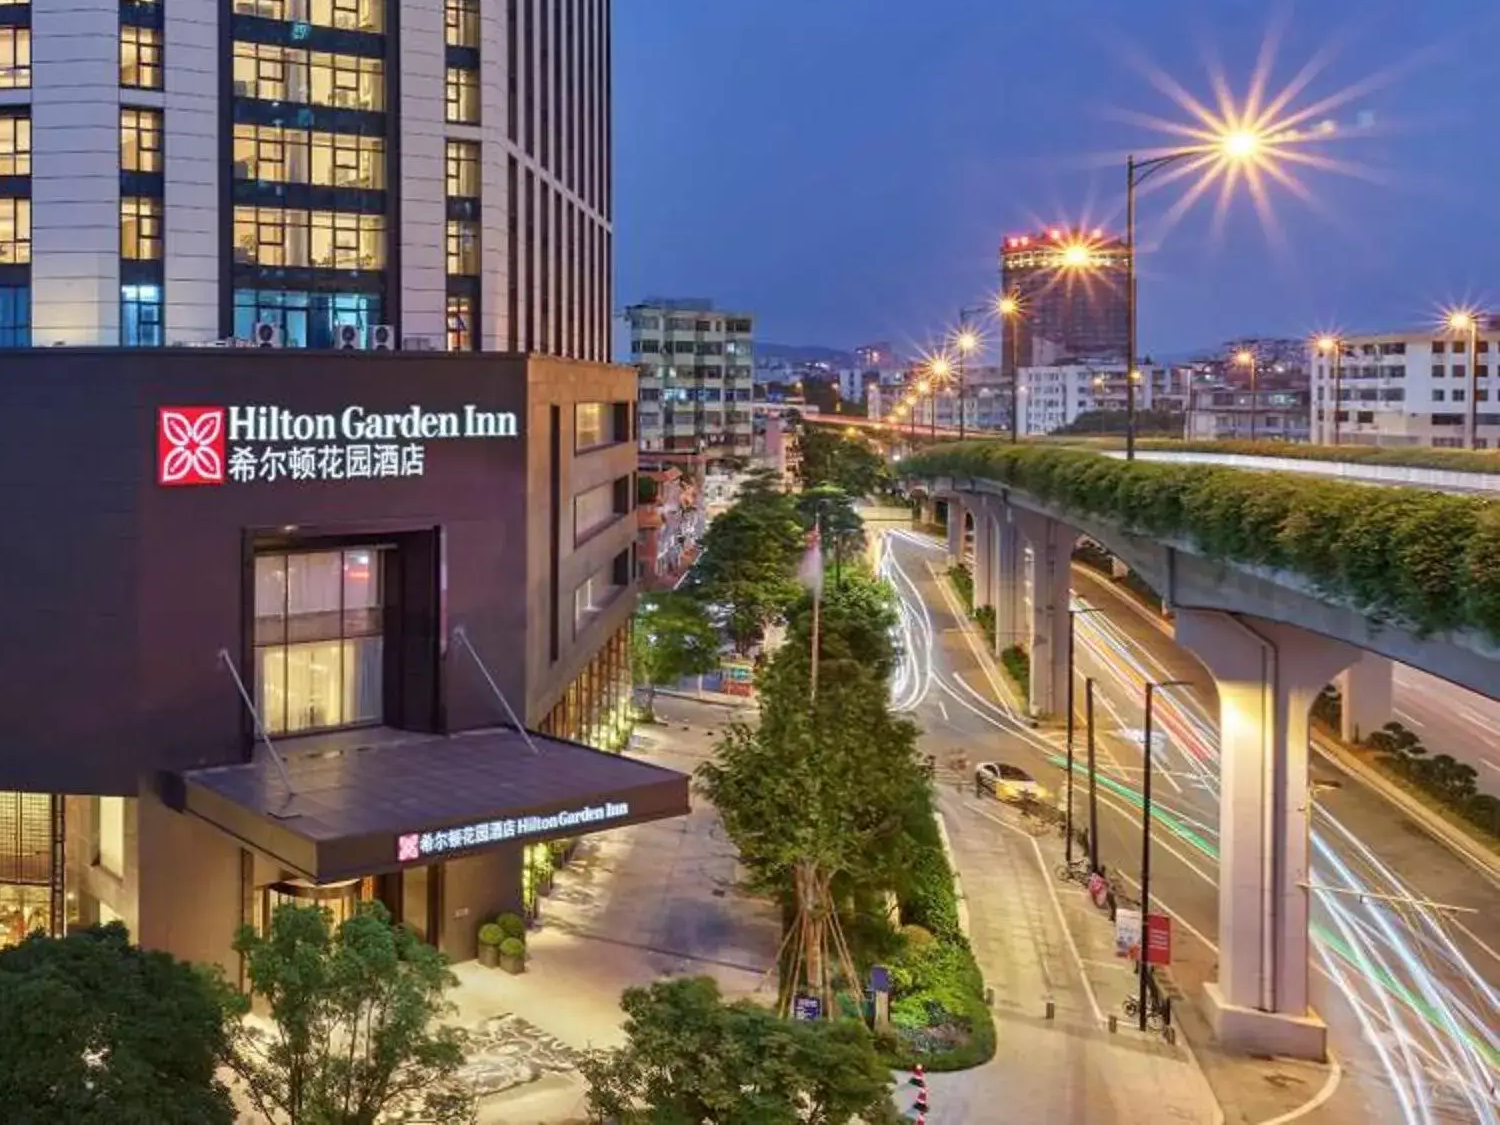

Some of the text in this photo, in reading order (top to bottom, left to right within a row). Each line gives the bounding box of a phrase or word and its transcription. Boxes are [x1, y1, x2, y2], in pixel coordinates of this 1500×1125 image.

[228, 405, 517, 441] Hilton Garden Inn
[228, 444, 425, 482] 希尔顿花园酒店
[420, 802, 629, 854] 希尔顿花园酒店 Hilton Garden Inn
